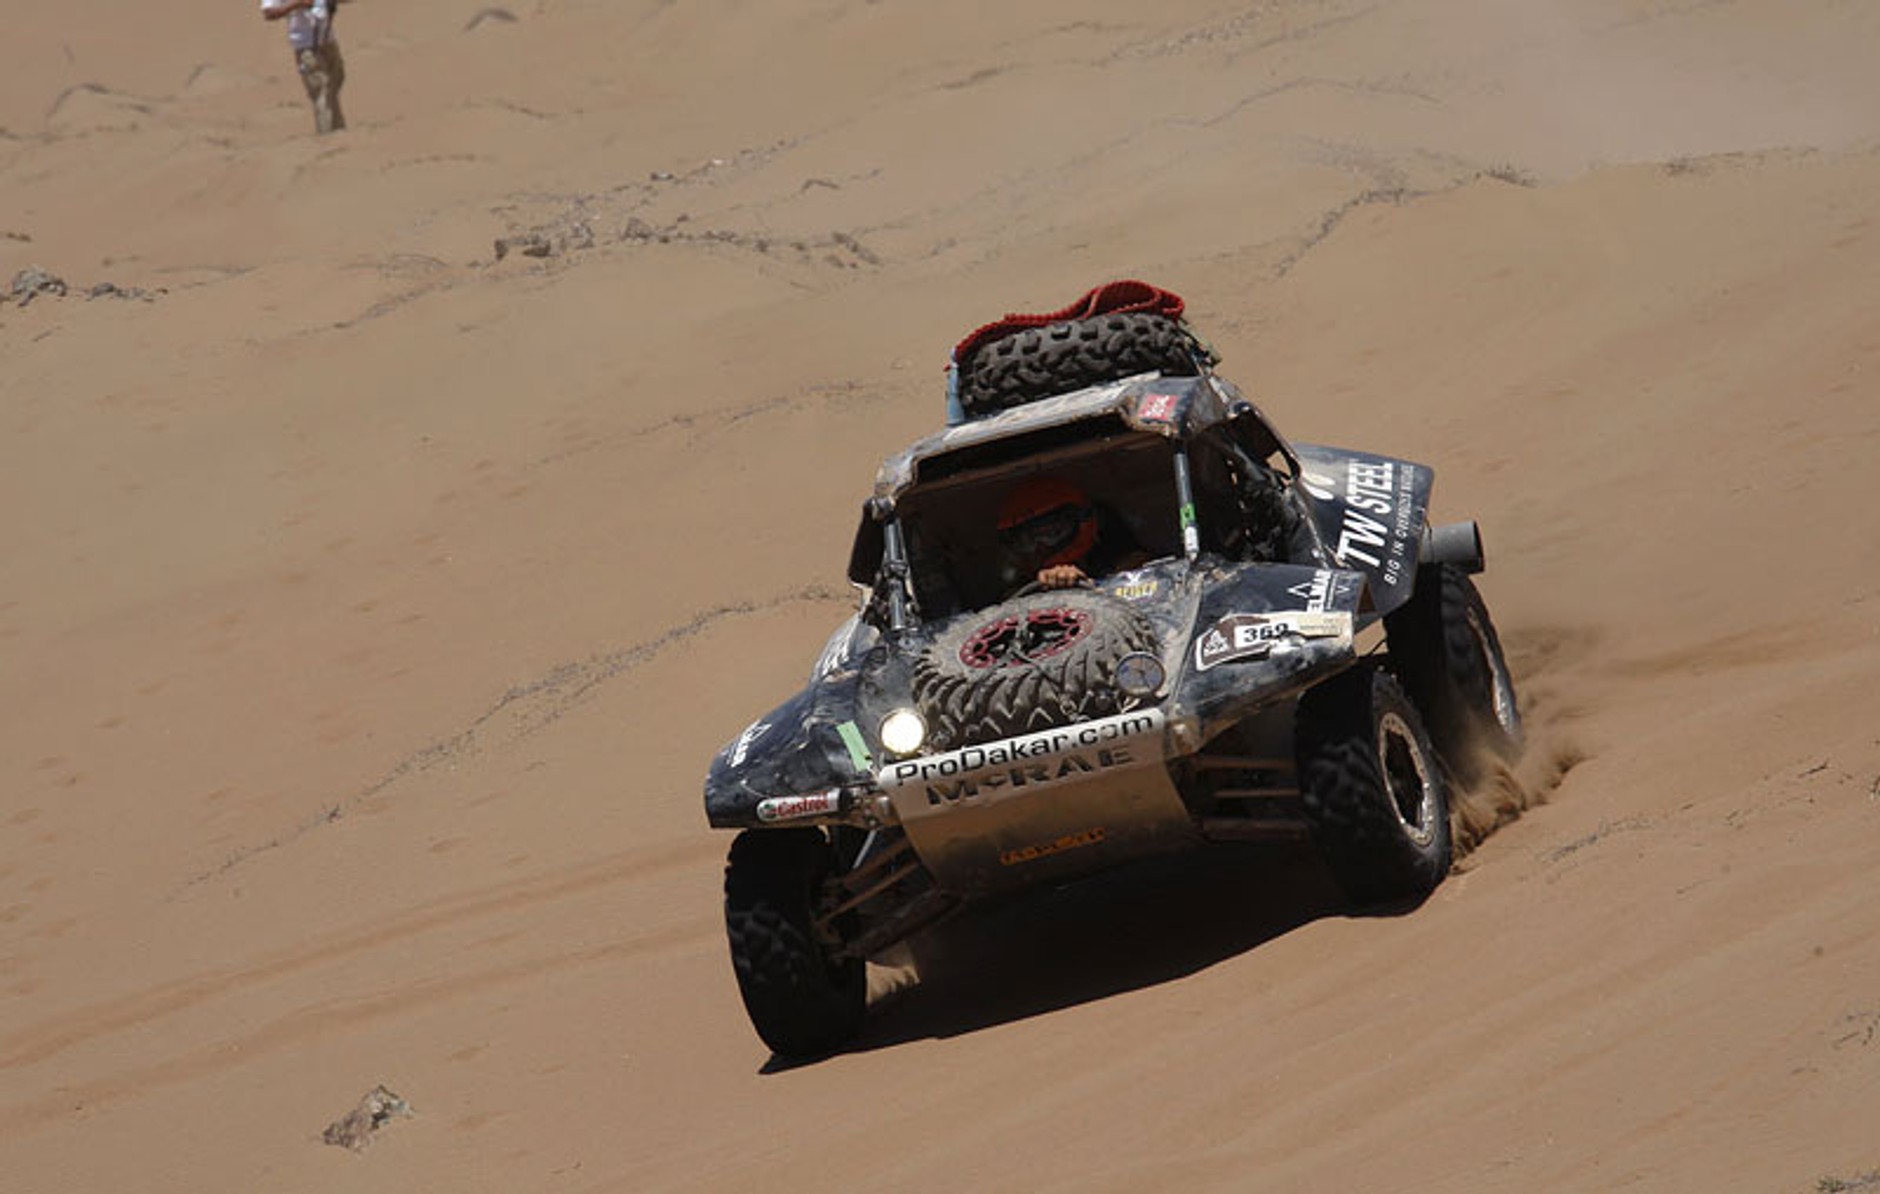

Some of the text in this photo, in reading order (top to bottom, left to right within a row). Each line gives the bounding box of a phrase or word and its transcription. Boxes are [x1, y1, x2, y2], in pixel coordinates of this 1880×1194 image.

[1337, 459, 1393, 567] TW STEEL
[1384, 559, 1401, 584] BIG
[895, 715, 1154, 787] ProDakar.com
[777, 793, 830, 817] Castrol
